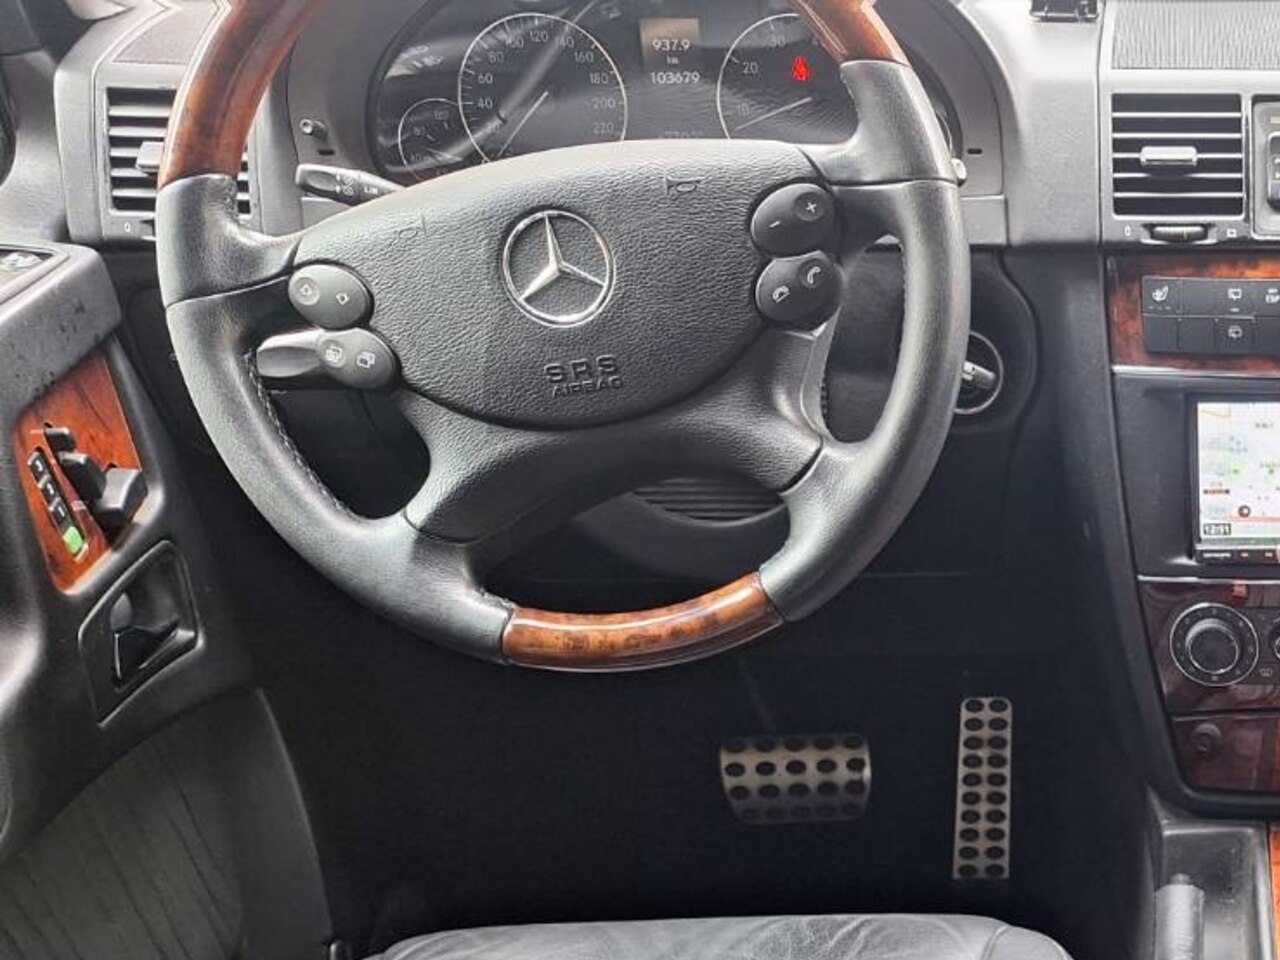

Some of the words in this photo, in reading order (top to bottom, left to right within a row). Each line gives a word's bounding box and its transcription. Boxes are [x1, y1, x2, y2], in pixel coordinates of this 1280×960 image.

[529, 31, 549, 42] 120
[555, 36, 575, 48] 140
[652, 38, 692, 51] 937.9
[574, 51, 594, 62] 160
[742, 62, 758, 74] 20
[477, 73, 494, 84] 60
[590, 72, 609, 84] 180
[650, 72, 700, 84] 103679
[477, 98, 494, 109] 40
[593, 98, 616, 109] 200
[544, 354, 618, 382] SRS
